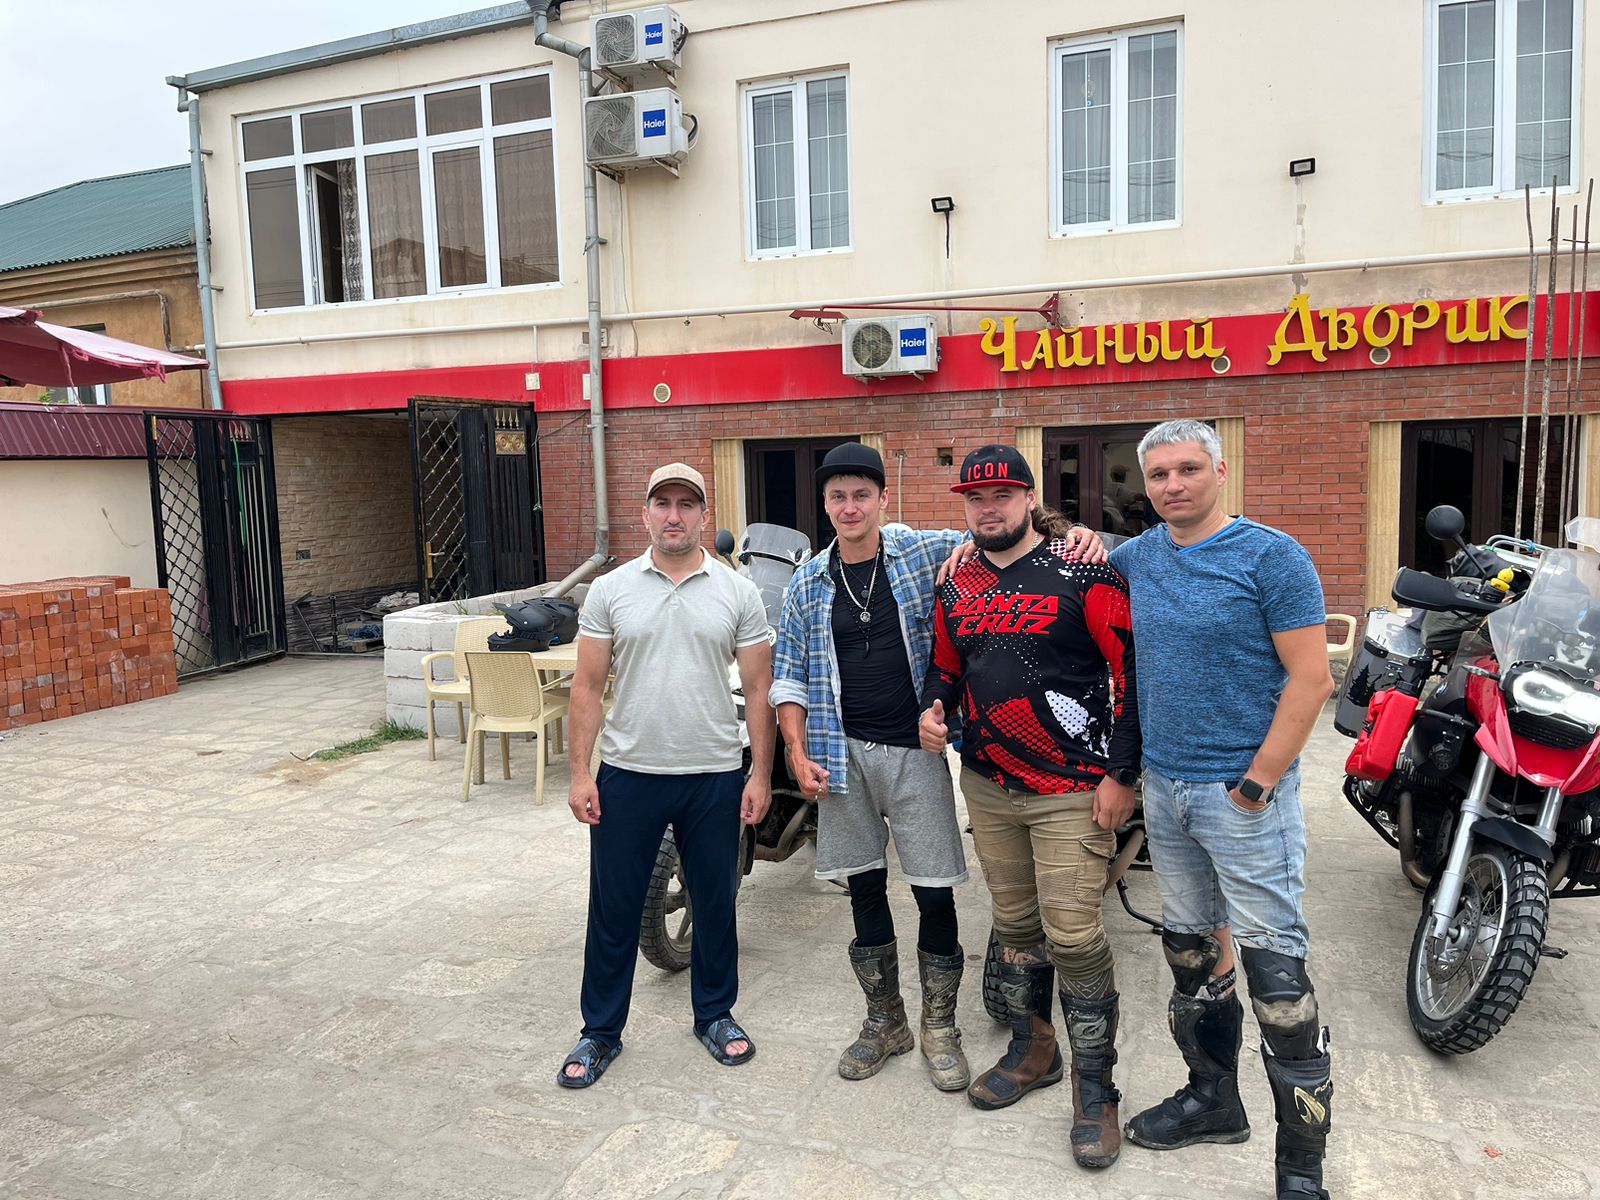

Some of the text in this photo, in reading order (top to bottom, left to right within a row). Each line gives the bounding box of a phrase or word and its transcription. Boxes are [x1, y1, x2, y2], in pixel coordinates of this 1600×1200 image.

[645, 30, 663, 39] Haier
[643, 119, 666, 129] Haier
[901, 337, 926, 348] Haier
[967, 462, 1009, 481] ICON
[948, 593, 1059, 617] SANTA
[956, 613, 1059, 637] CRUZ
